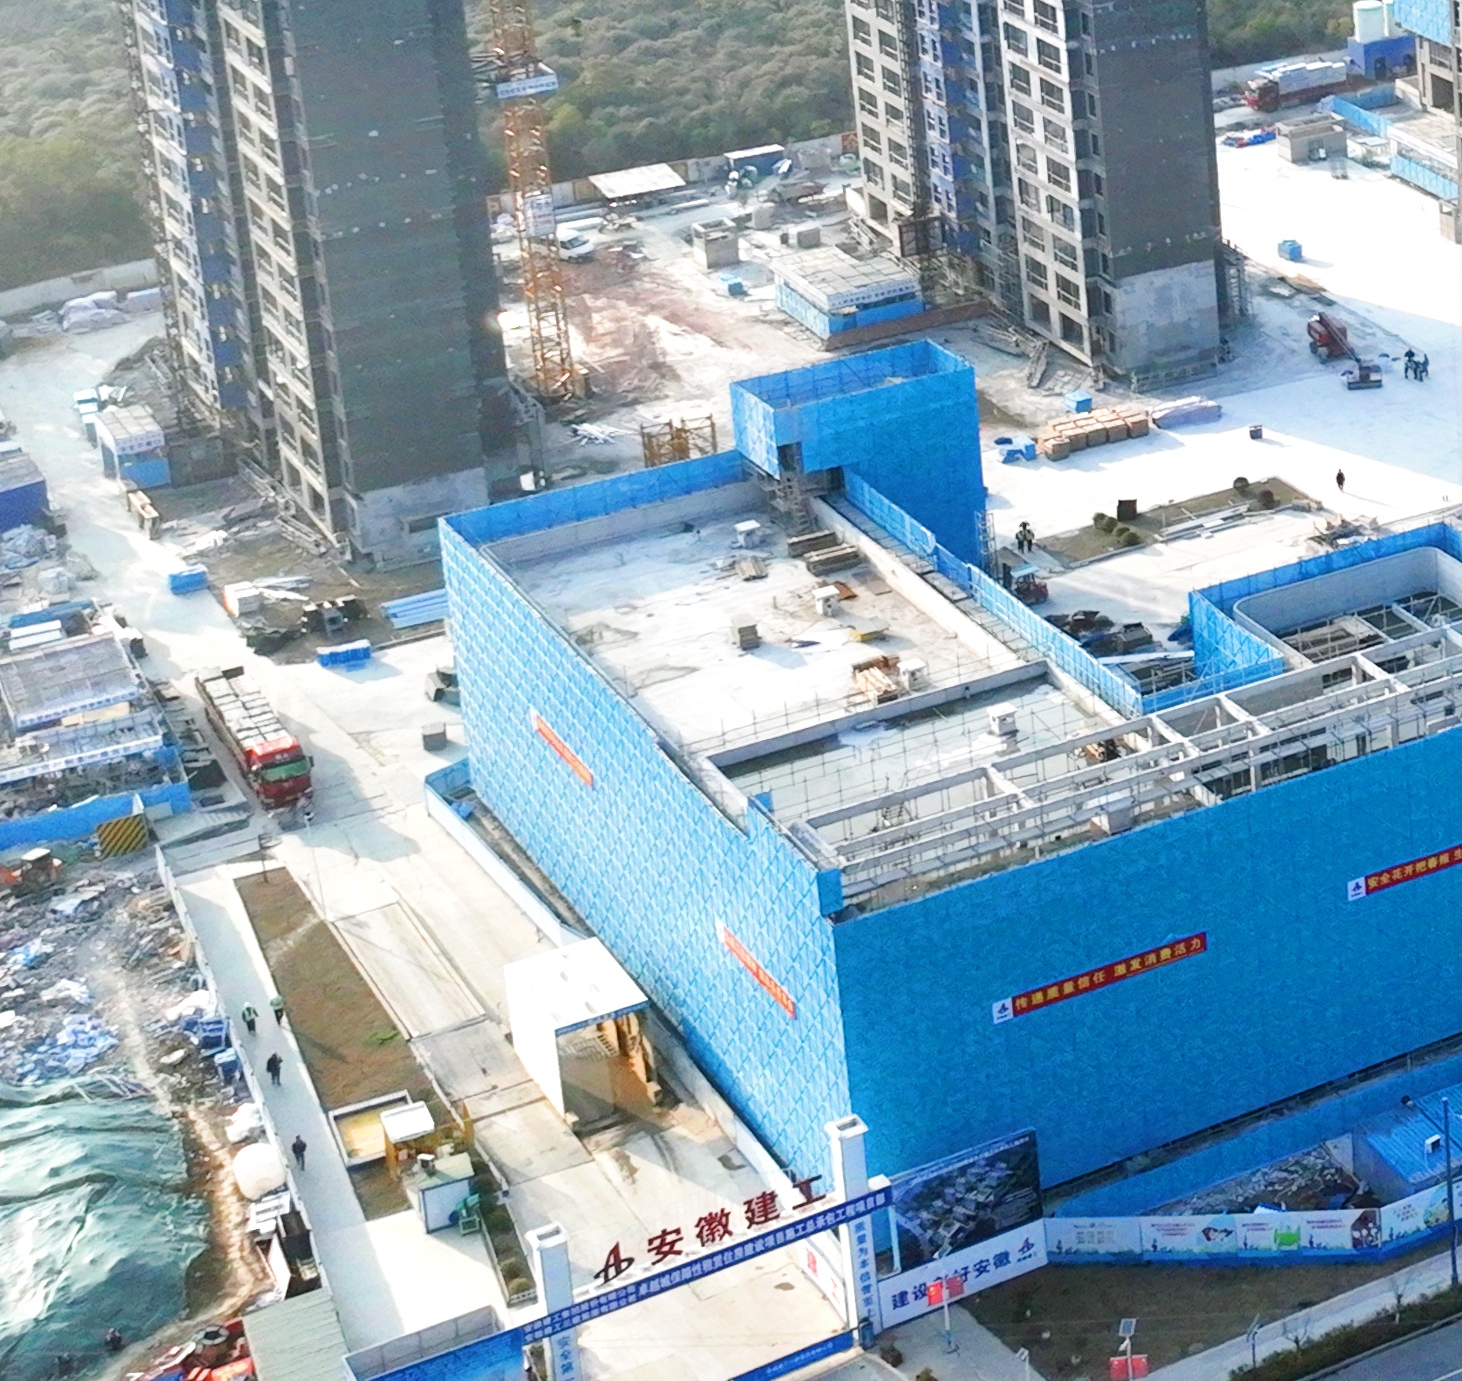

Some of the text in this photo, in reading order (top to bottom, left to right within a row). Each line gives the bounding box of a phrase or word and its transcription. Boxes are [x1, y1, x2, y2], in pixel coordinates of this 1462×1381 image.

[1015, 937, 1202, 1011] 传递质量信任 激发消费活力
[647, 1174, 826, 1266] 安徽建工
